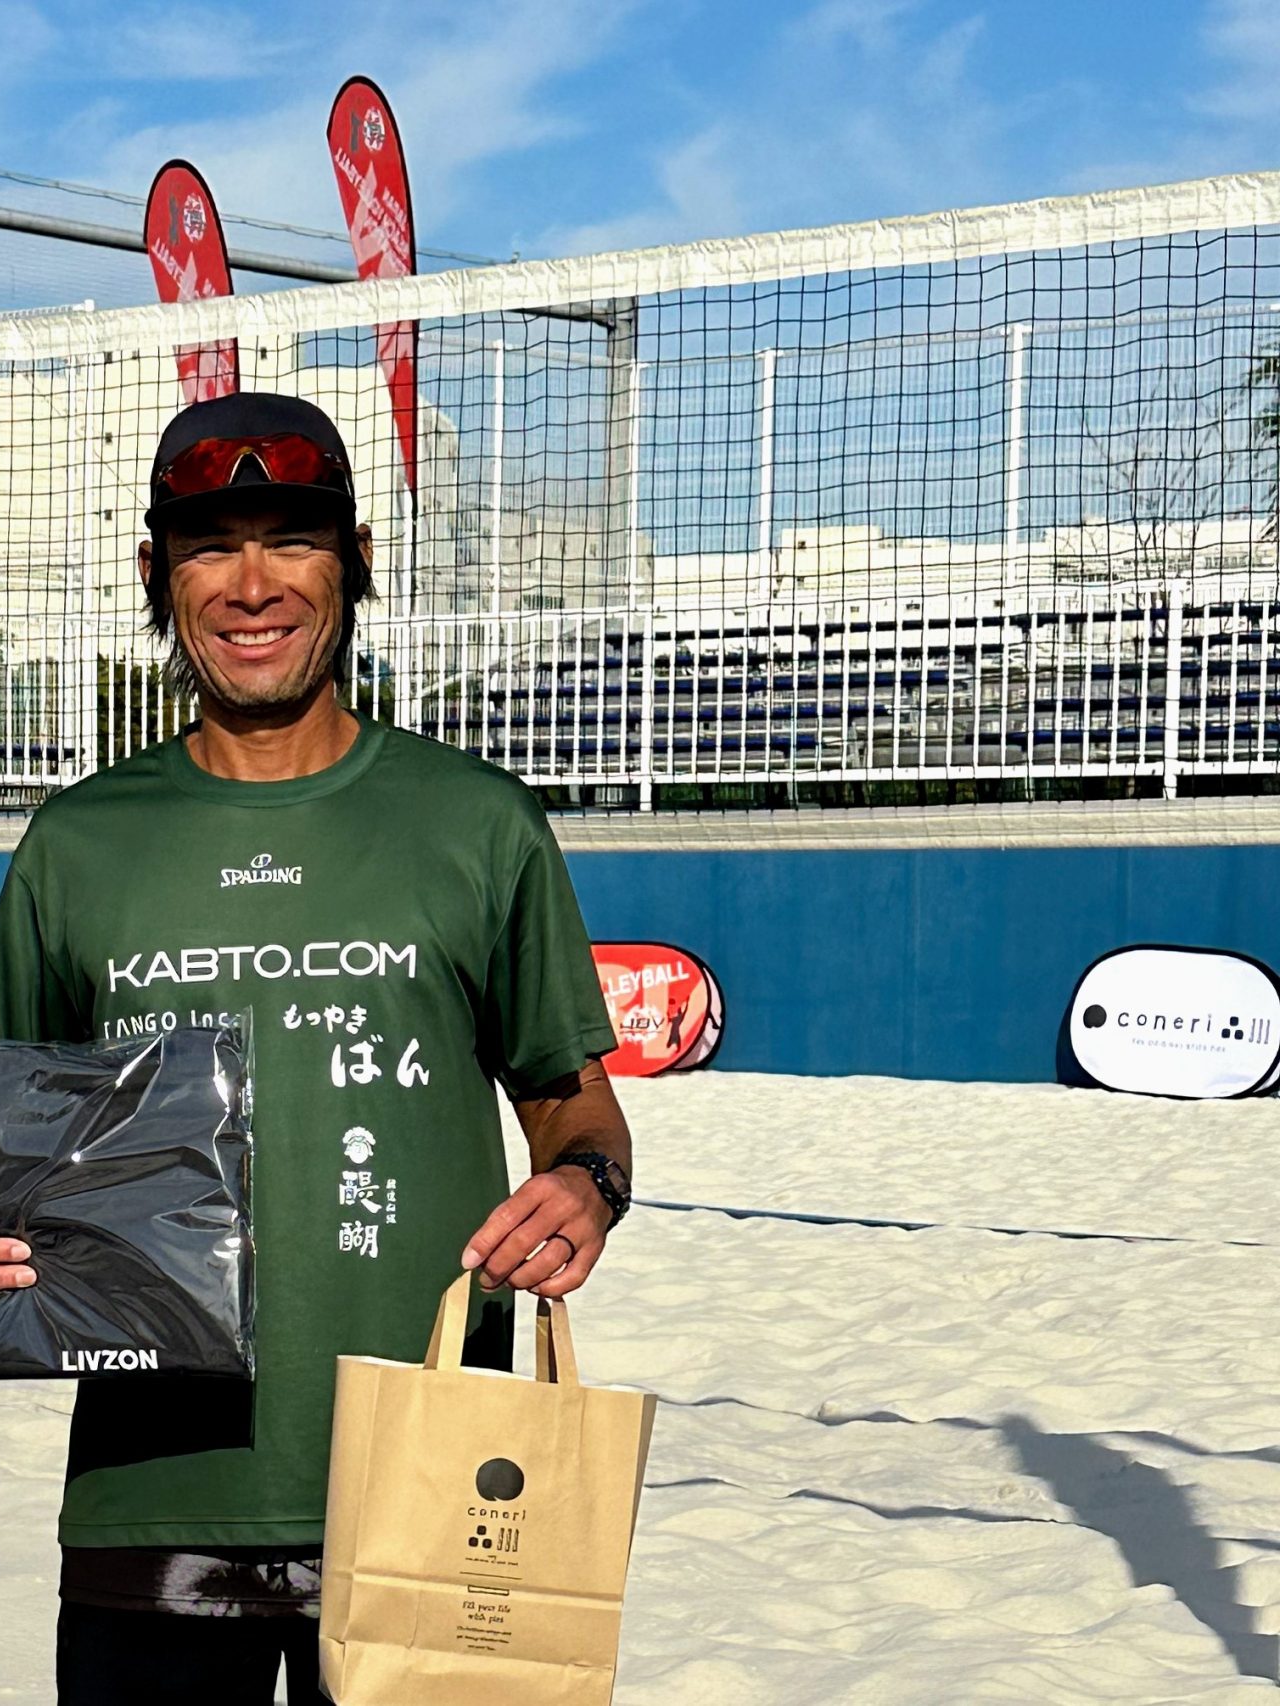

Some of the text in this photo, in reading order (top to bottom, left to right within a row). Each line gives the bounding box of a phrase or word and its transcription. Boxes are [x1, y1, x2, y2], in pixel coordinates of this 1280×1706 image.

[220, 866, 303, 888] SPALDING
[107, 940, 417, 993] KABTO.COM
[604, 961, 690, 997] LEYBALL
[1117, 1012, 1212, 1033] coneri
[61, 1350, 158, 1372] LIVZON
